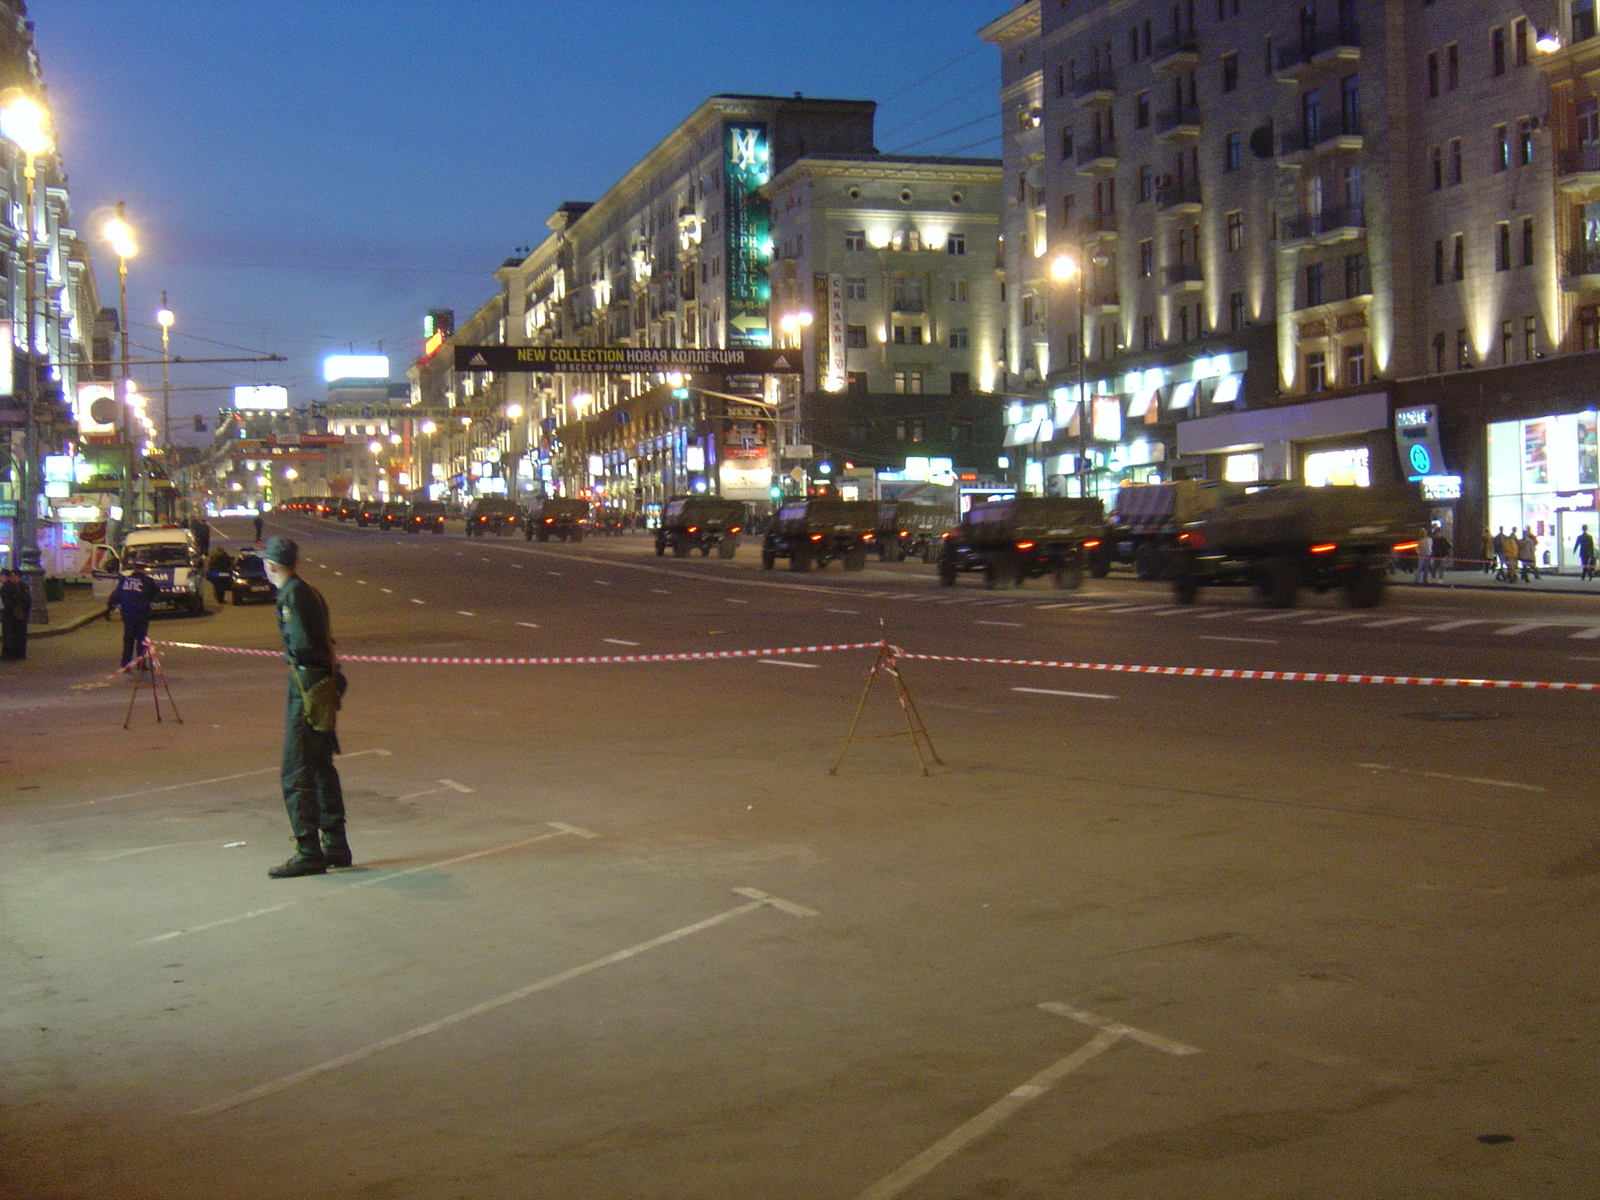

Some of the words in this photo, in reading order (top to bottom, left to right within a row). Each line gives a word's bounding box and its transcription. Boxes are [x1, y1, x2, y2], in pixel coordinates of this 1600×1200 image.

[517, 348, 546, 361] NEW
[550, 349, 625, 362] COLLECTION
[626, 350, 668, 363] НОВАЯ
[671, 350, 745, 365] КОЛЛЕКЦИЯ
